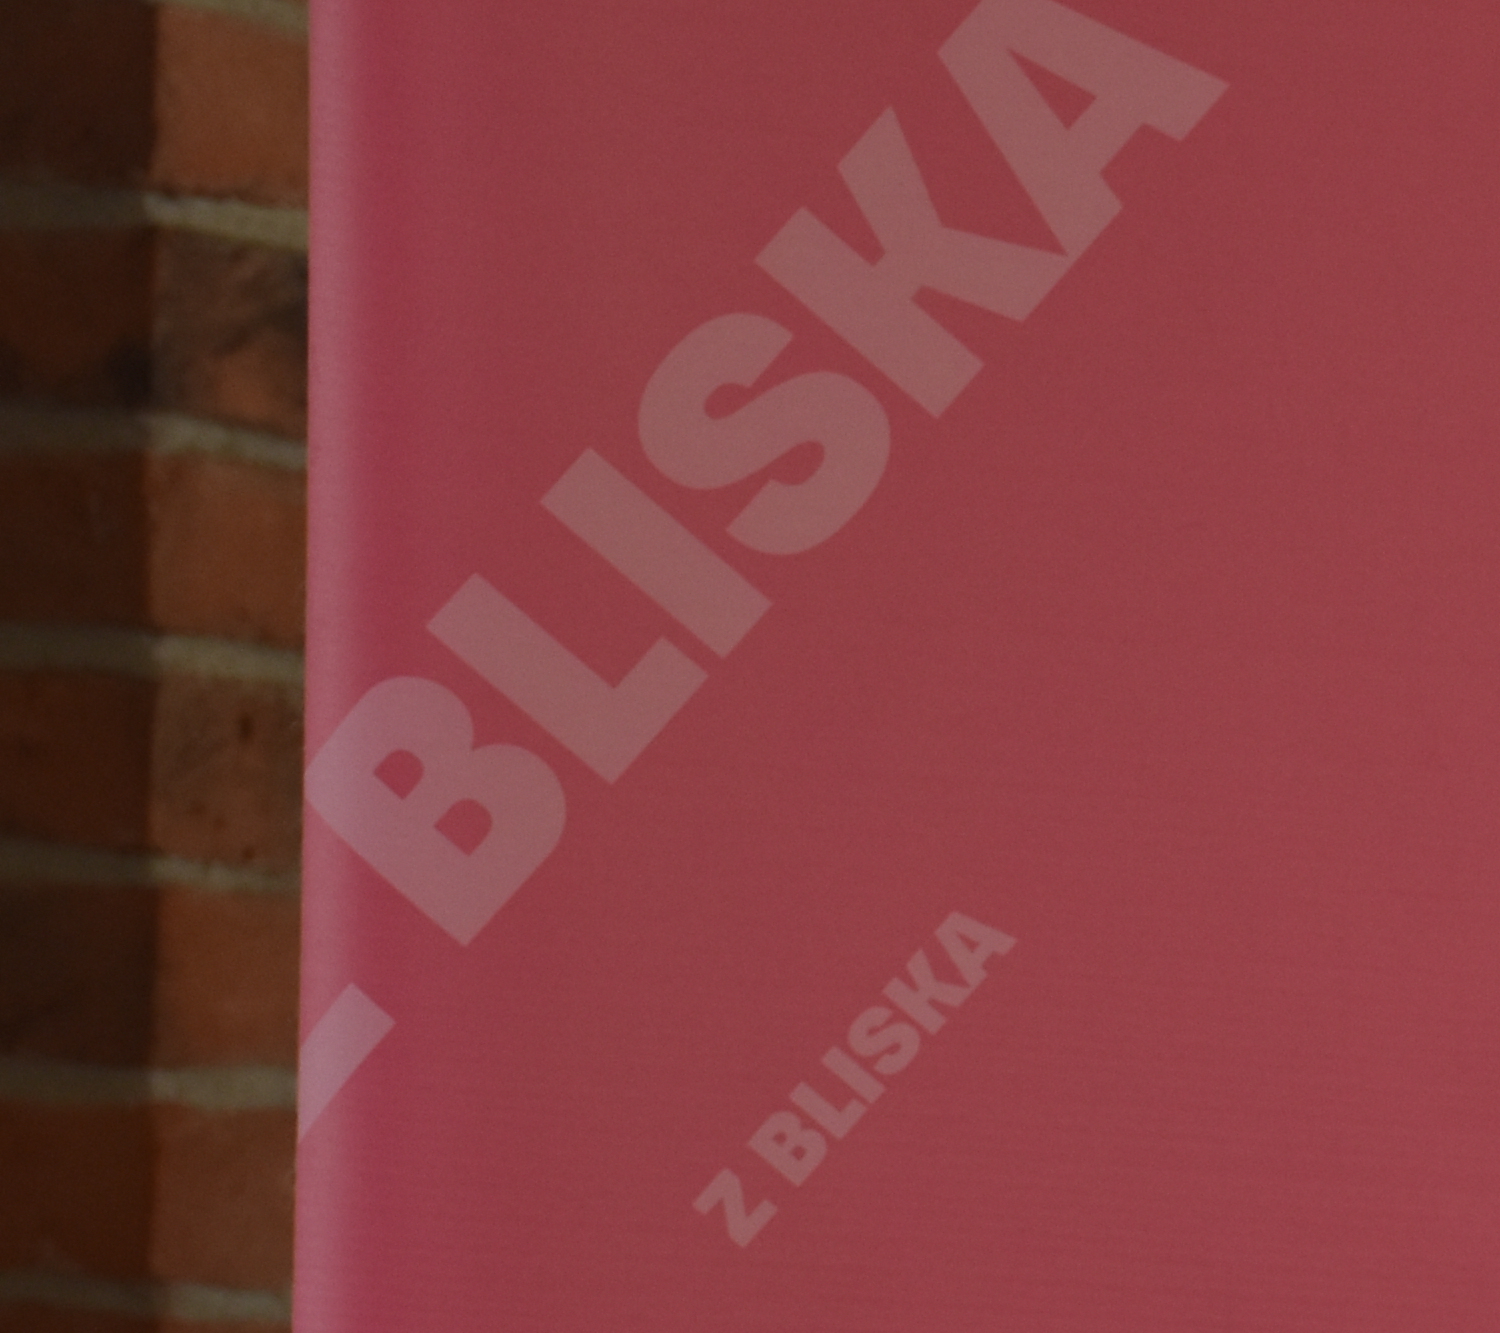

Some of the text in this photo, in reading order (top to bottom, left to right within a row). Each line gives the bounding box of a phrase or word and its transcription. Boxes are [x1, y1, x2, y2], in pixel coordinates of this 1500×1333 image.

[303, 0, 1231, 946] BLISKA
[692, 910, 1018, 1248] Z BLISKA
